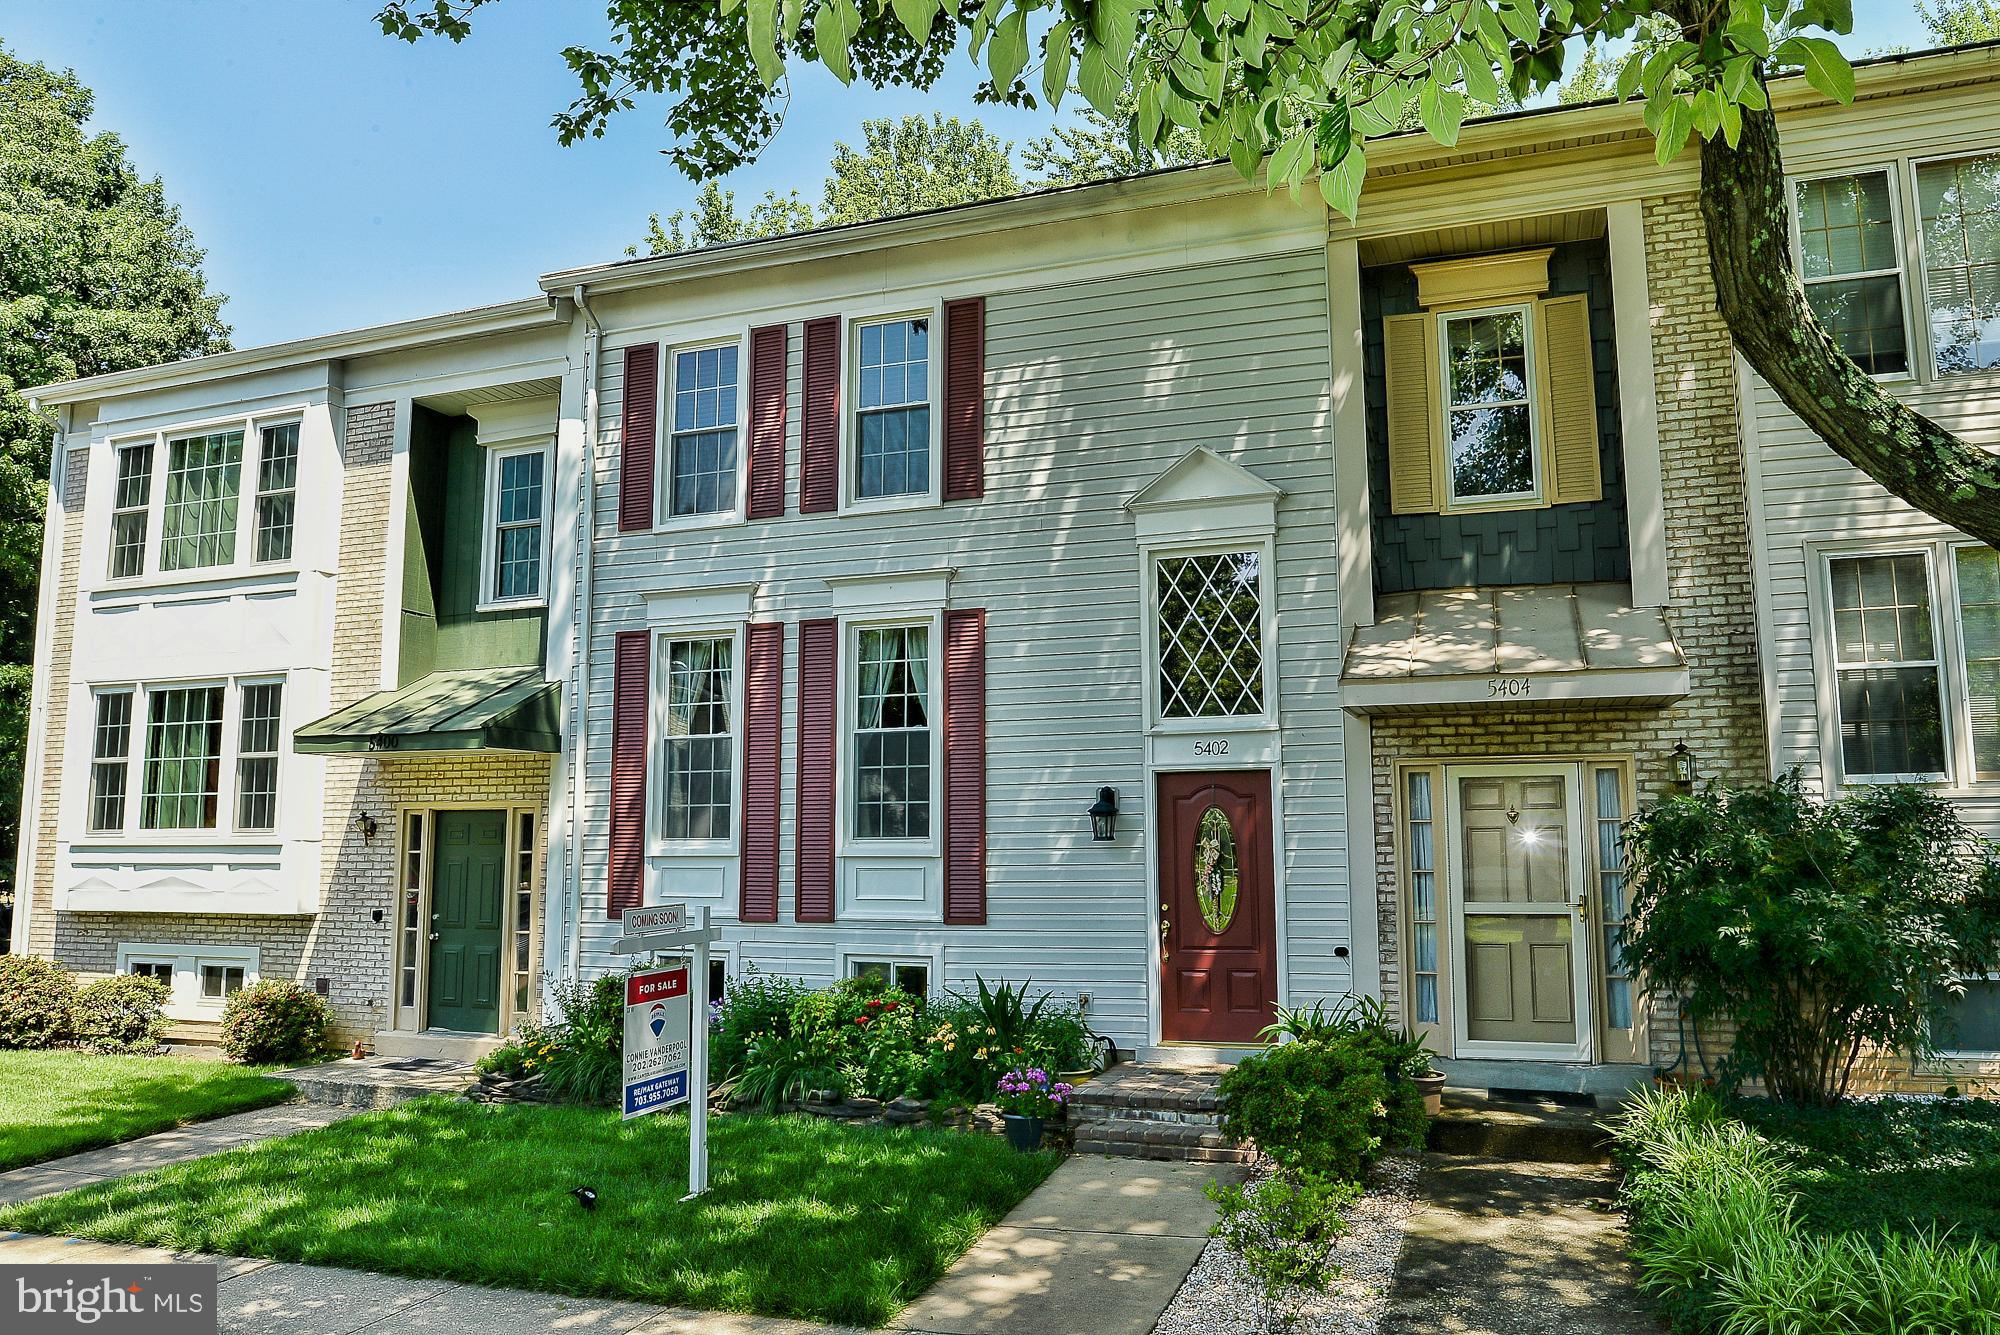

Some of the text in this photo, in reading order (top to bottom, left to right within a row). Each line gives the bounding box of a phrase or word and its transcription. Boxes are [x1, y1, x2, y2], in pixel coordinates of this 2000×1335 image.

[1487, 678, 1531, 698] 5404
[368, 735, 399, 751] 5400
[1194, 740, 1229, 756] 5402
[631, 911, 680, 928] COMING SOON!
[639, 979, 677, 995] FOR SALE
[626, 1040, 687, 1064] CONNIE VANDERPOOL
[632, 1051, 681, 1072] 202.262.7062
[633, 1077, 680, 1097] RE/MAX GATEWAY
[634, 1086, 679, 1107] 703.955.7050
